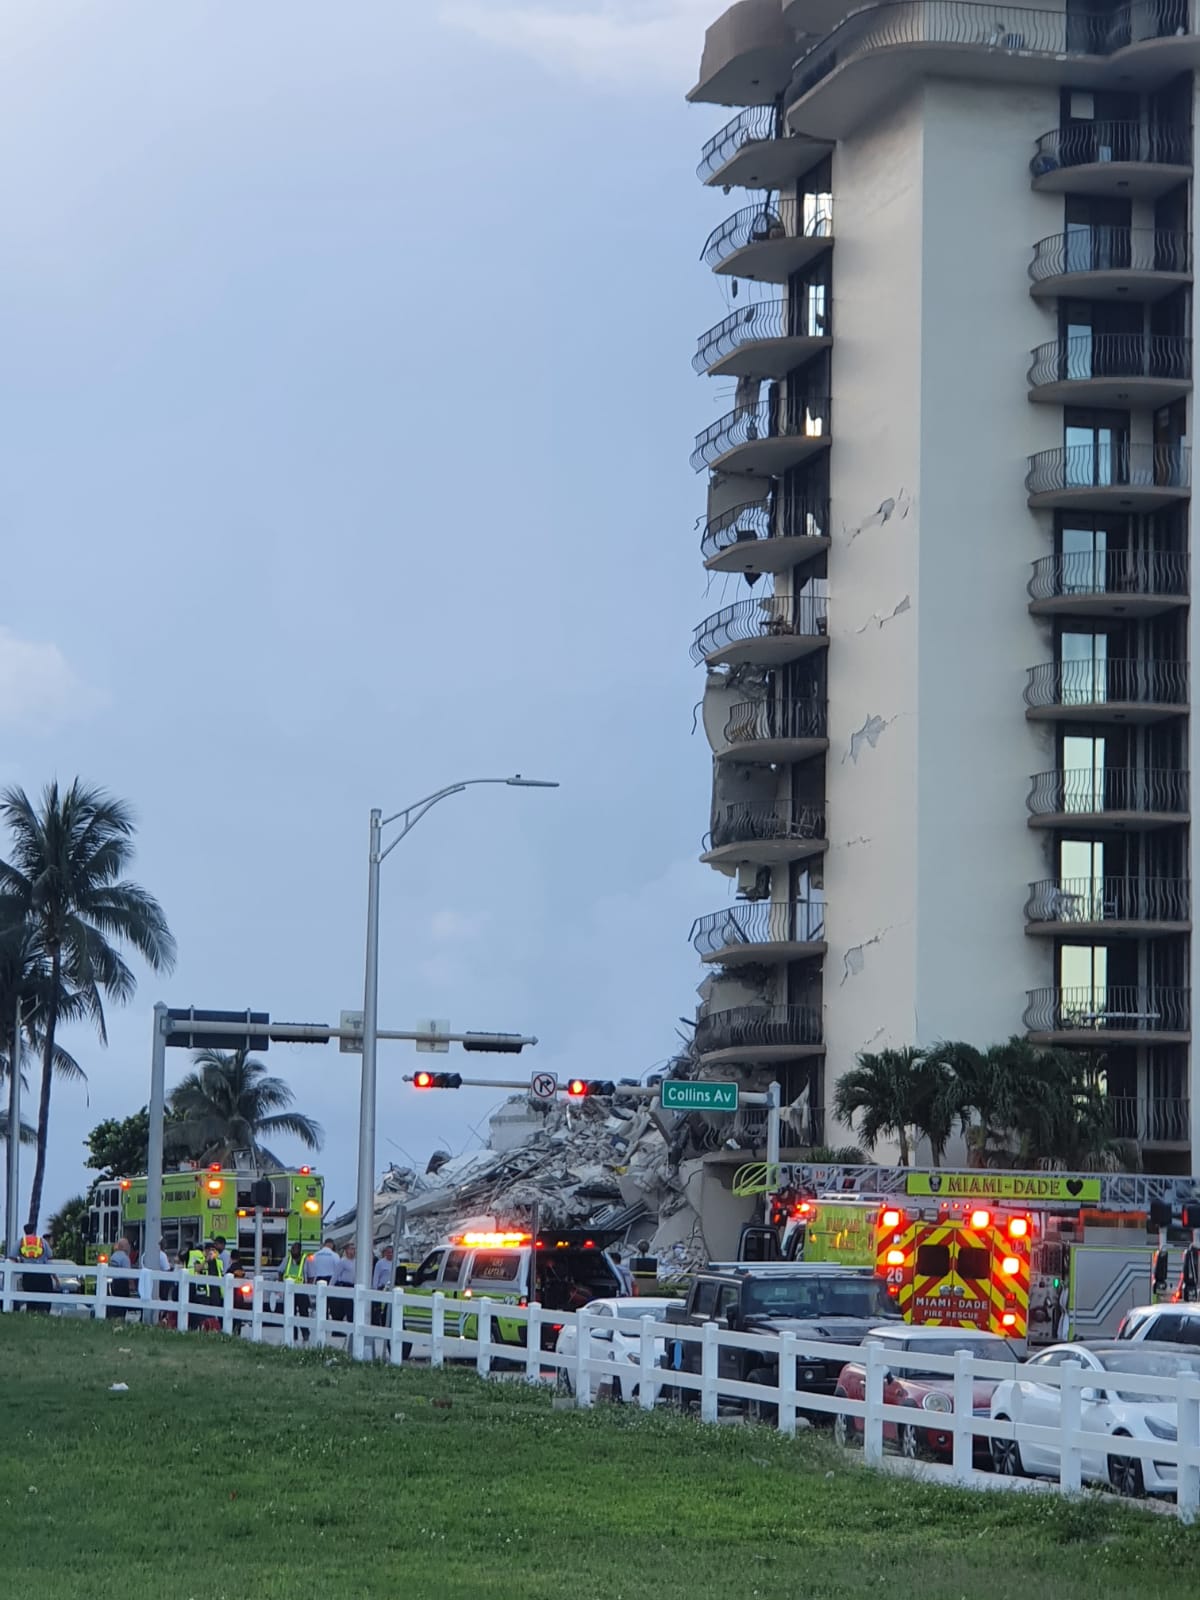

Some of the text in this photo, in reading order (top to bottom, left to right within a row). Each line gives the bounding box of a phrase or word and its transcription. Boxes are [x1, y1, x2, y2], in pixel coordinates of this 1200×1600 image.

[668, 1087, 732, 1103] Collins Av
[949, 1176, 1061, 1195] MIAMI-DADE
[886, 1266, 904, 1283] 26
[923, 1309, 979, 1320] FIRE RESCUE
